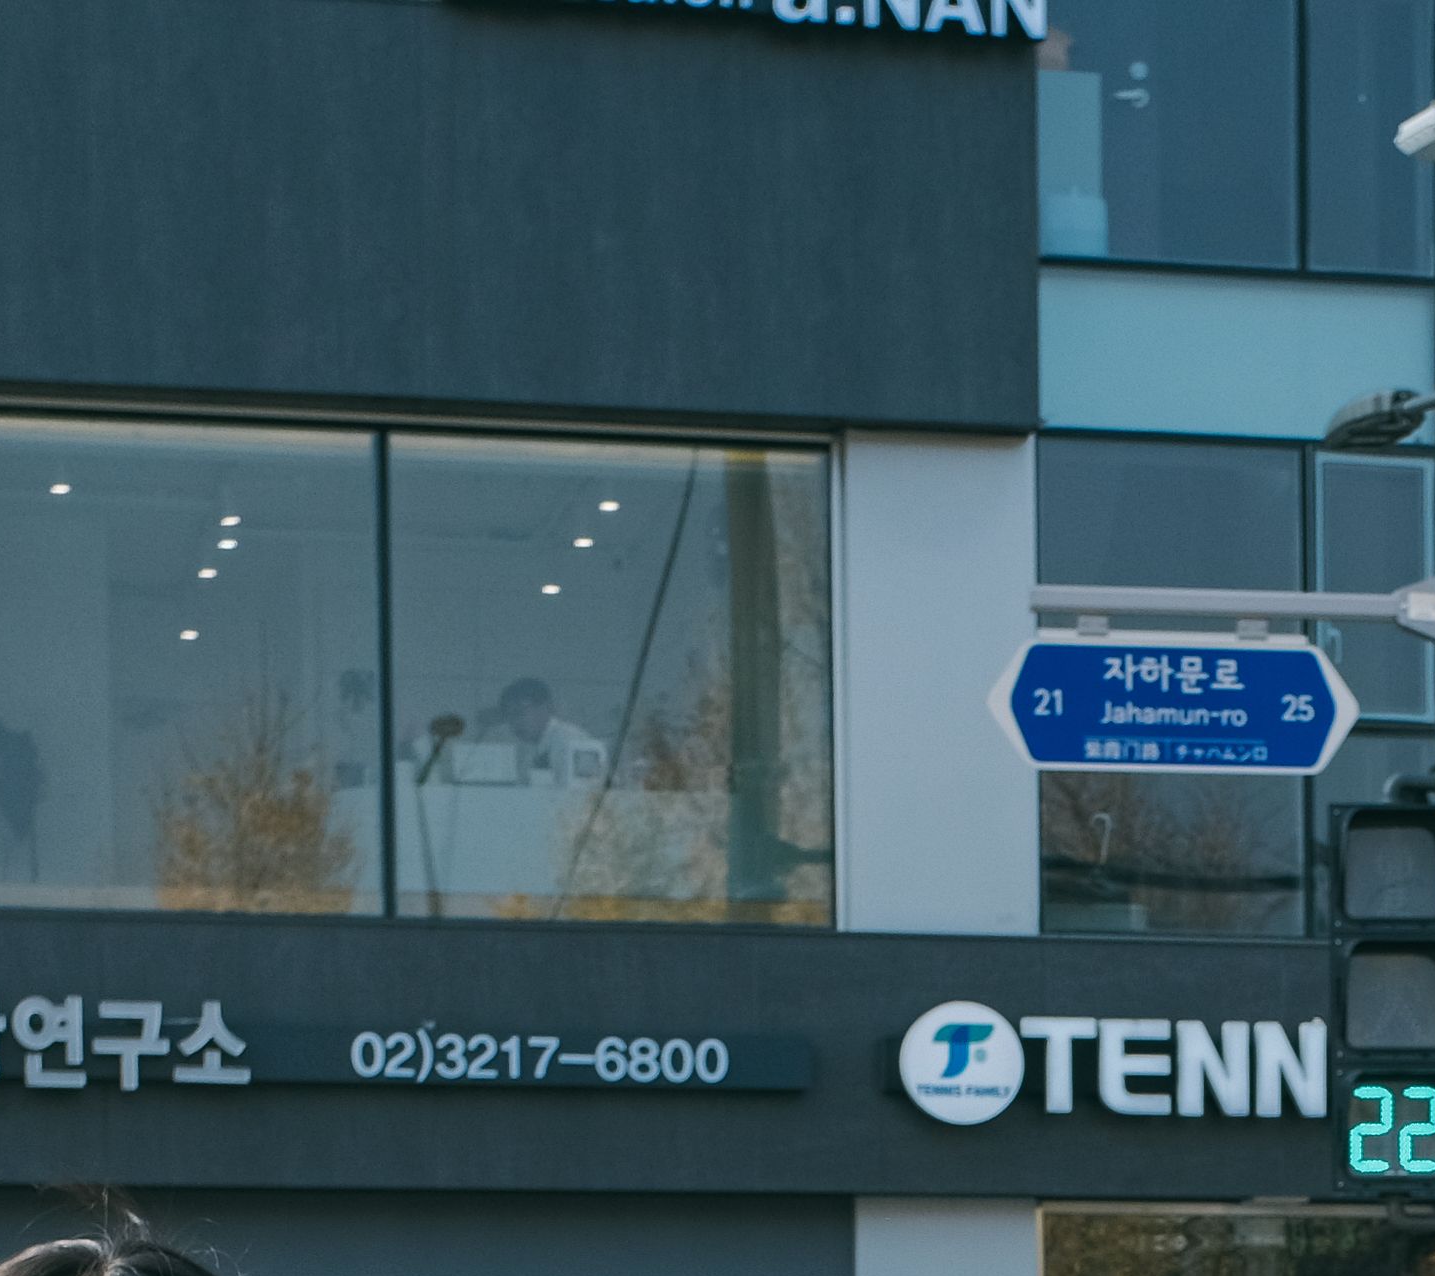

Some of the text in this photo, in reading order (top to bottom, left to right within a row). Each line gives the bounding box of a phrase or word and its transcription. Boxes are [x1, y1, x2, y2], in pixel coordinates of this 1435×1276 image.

[1103, 653, 1245, 695] 자하문로
[1033, 688, 1064, 717] 21
[1100, 700, 1248, 728] Jahamun-ro
[1280, 695, 1316, 722] 25
[349, 1028, 730, 1083] 02)3217-6800
[1020, 1016, 1327, 1118] TENN
